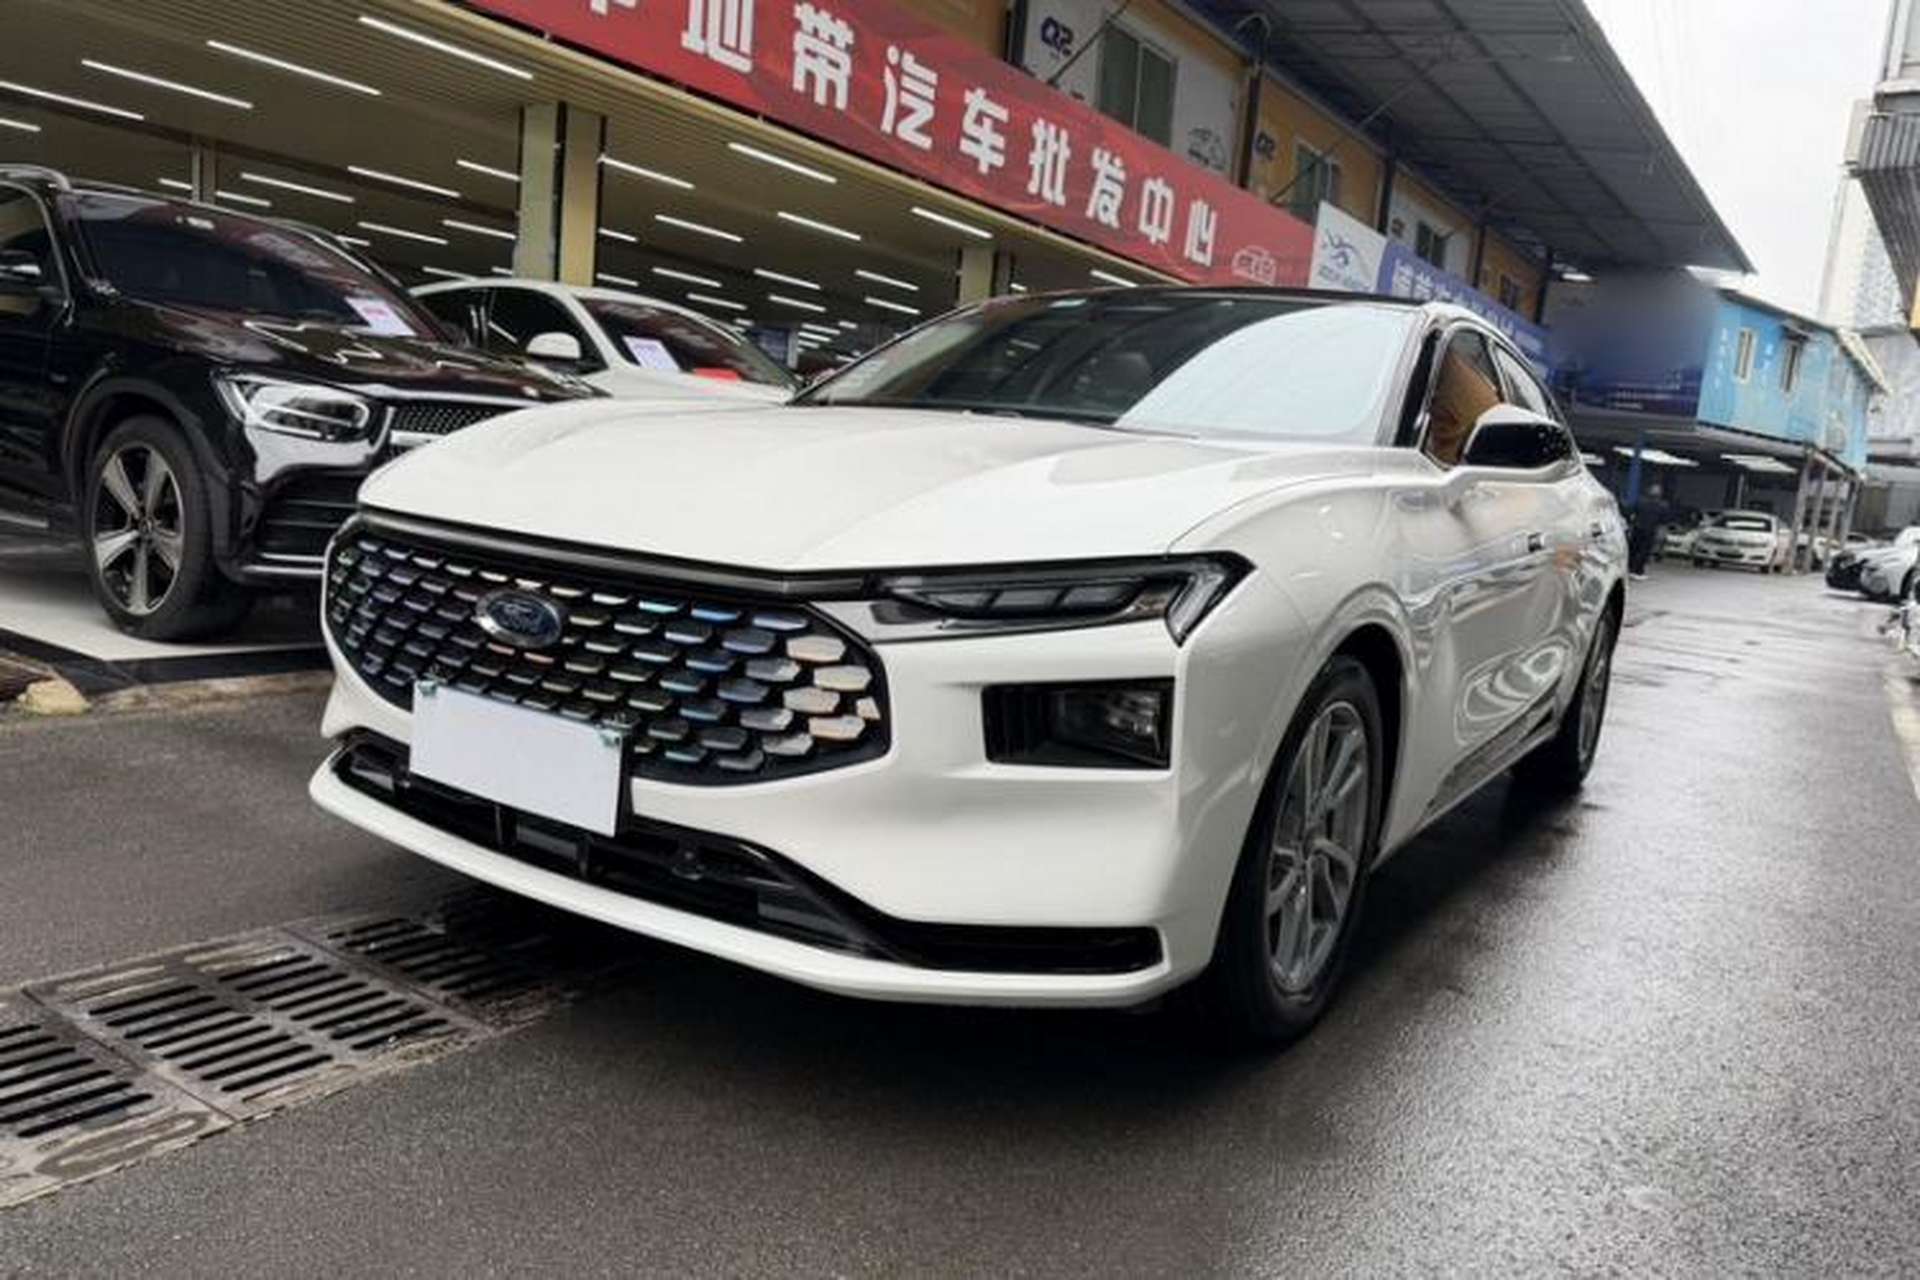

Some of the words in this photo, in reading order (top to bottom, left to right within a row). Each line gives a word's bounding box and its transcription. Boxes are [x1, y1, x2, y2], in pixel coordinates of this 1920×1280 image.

[590, 0, 1215, 268] 地带汽车批发中心
